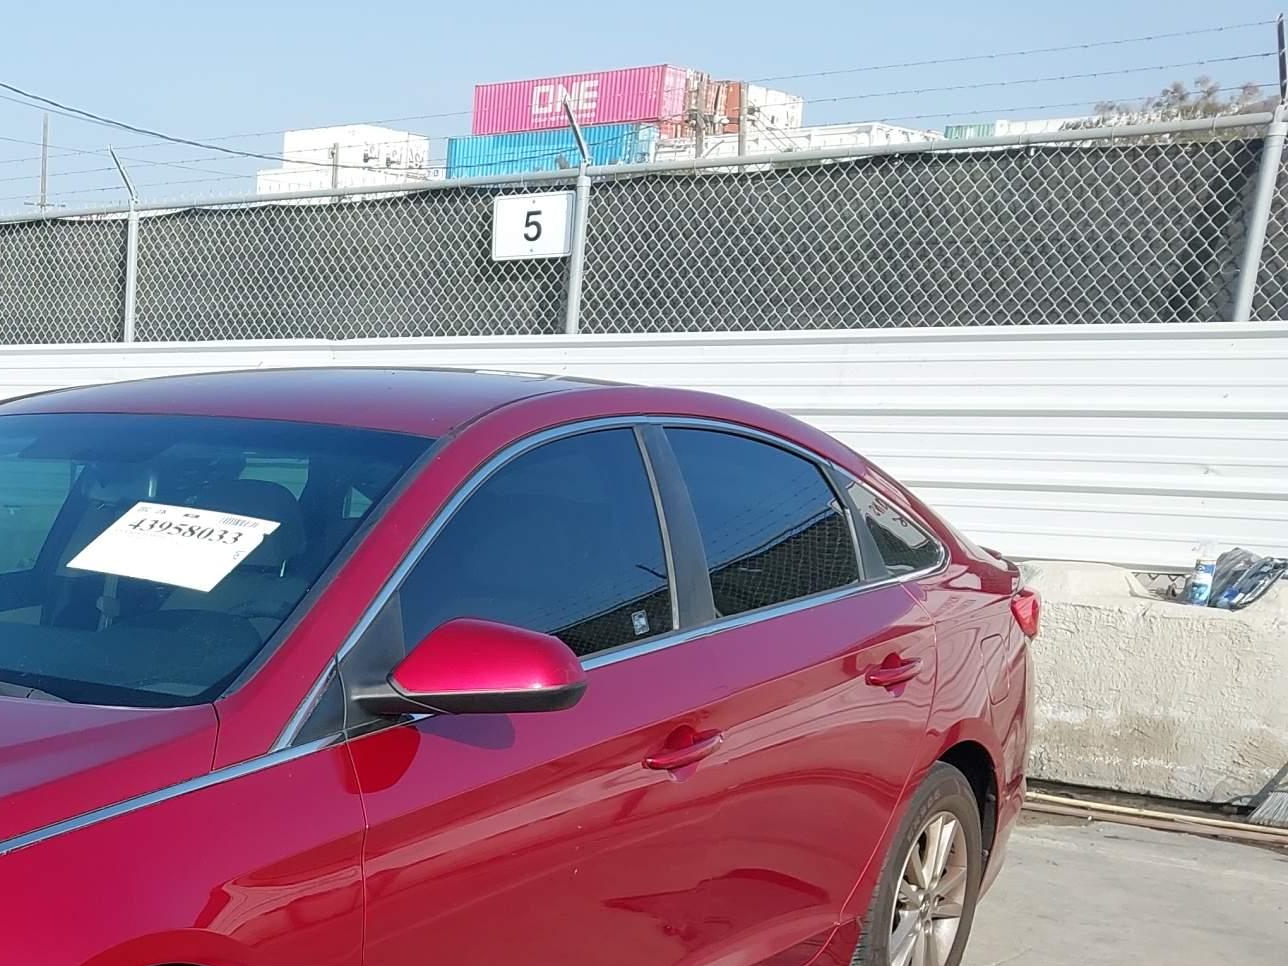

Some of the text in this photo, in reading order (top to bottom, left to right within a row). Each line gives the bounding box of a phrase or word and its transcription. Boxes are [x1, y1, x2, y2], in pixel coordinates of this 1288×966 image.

[532, 79, 598, 114] ONE
[522, 209, 542, 242] 5
[128, 518, 243, 545] 43958033
